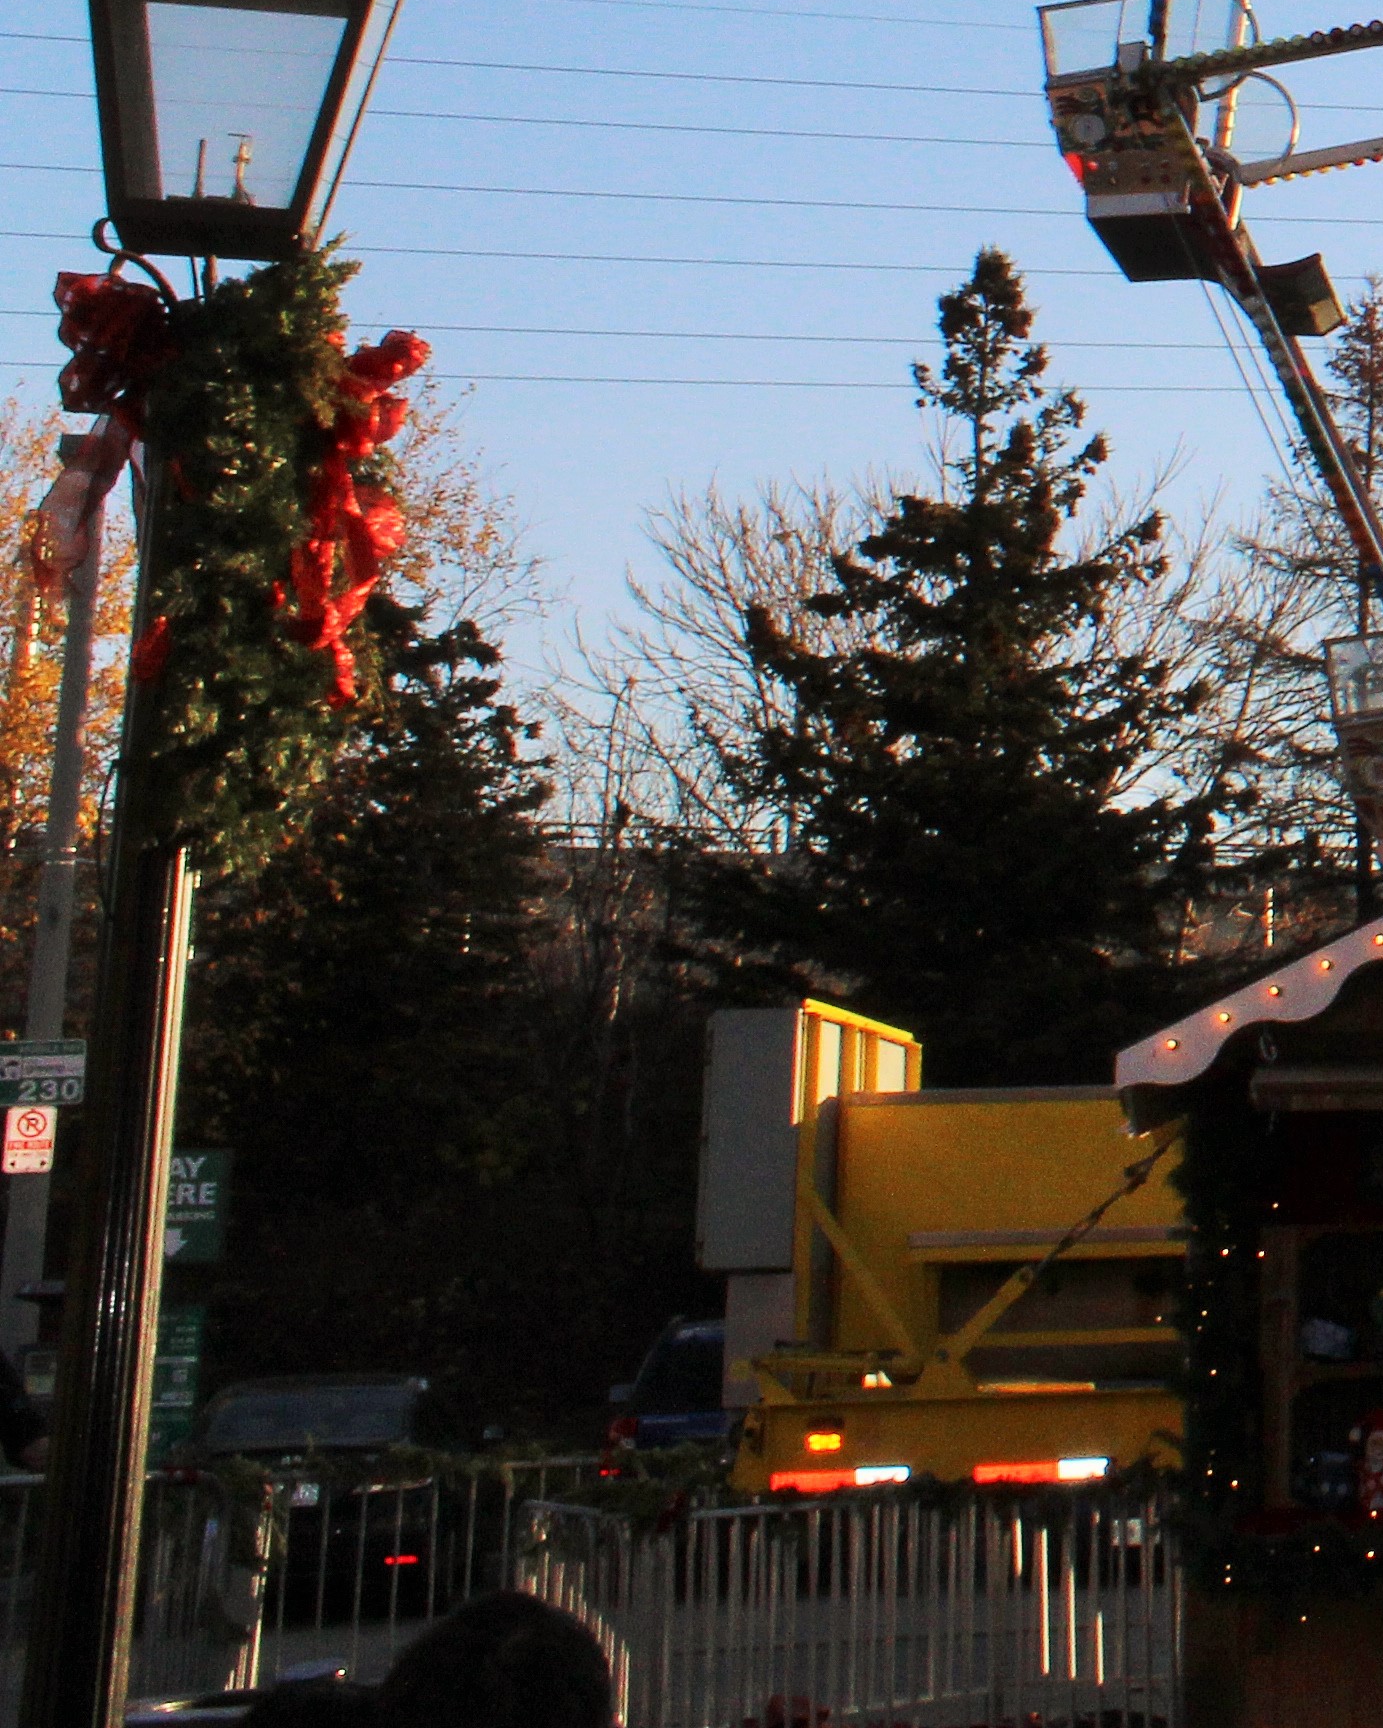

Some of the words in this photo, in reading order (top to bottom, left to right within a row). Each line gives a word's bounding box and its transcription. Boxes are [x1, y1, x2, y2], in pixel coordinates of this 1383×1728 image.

[19, 1078, 80, 1101] 230
[171, 1157, 207, 1179] AY
[168, 1182, 217, 1205] RE
